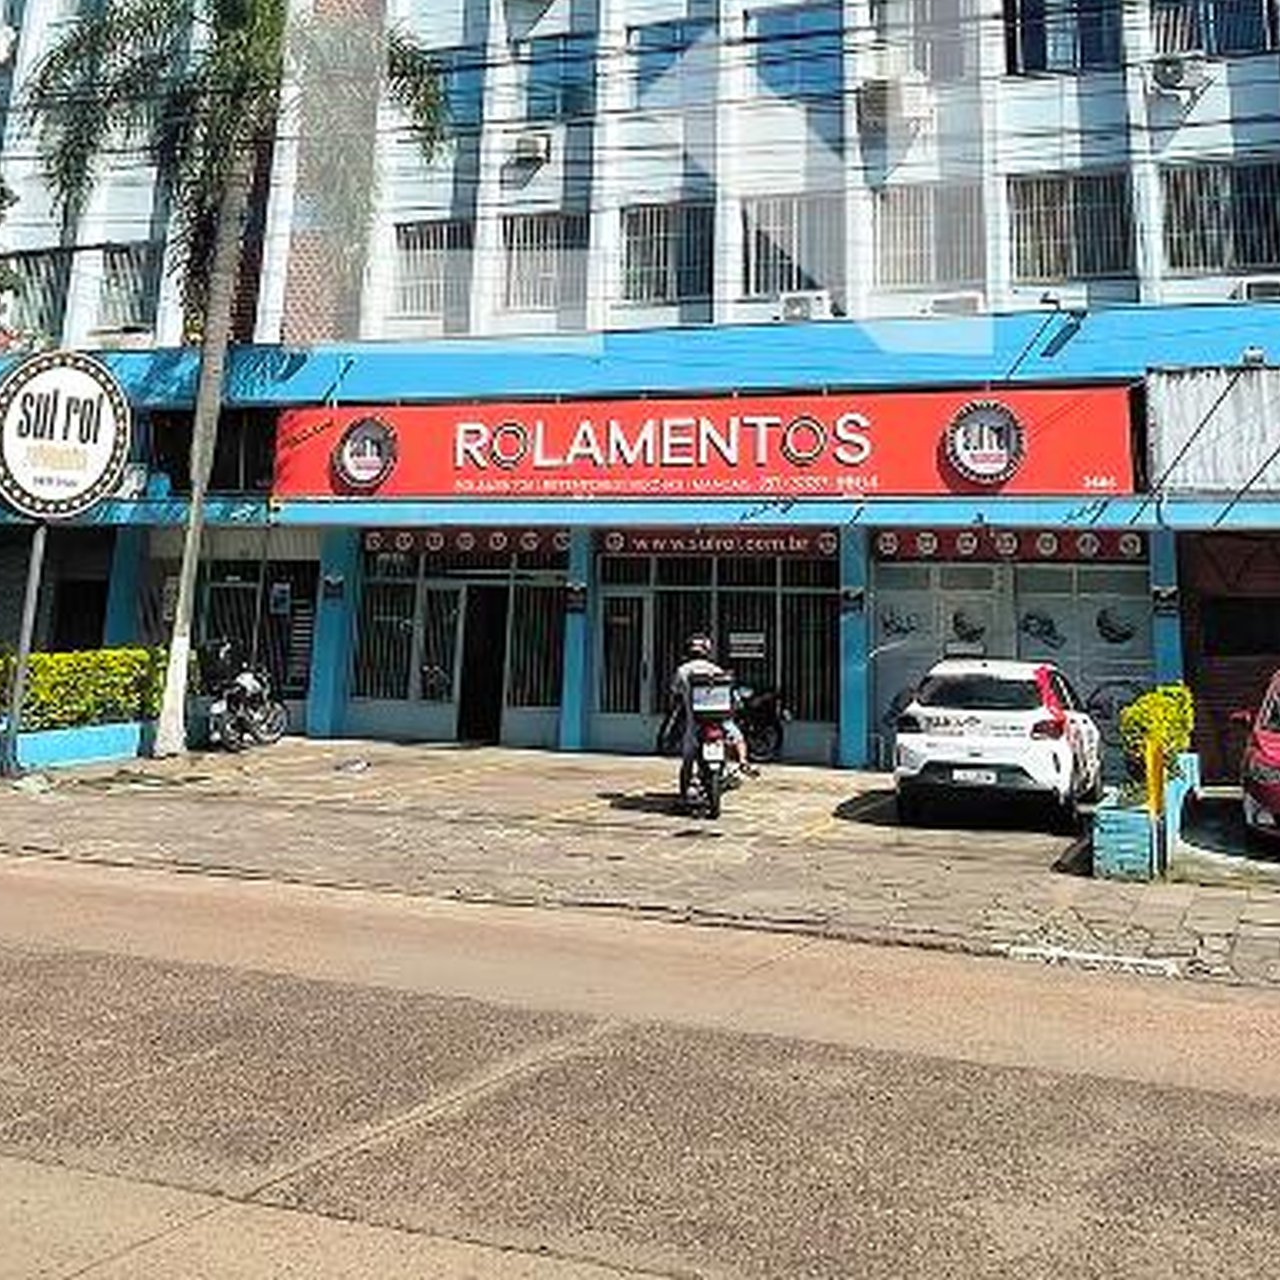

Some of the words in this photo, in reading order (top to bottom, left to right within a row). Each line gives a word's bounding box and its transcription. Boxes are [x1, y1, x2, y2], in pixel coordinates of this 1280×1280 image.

[17, 388, 60, 440] sul
[62, 392, 105, 445] rol
[454, 413, 872, 470] ROLAMENTOS
